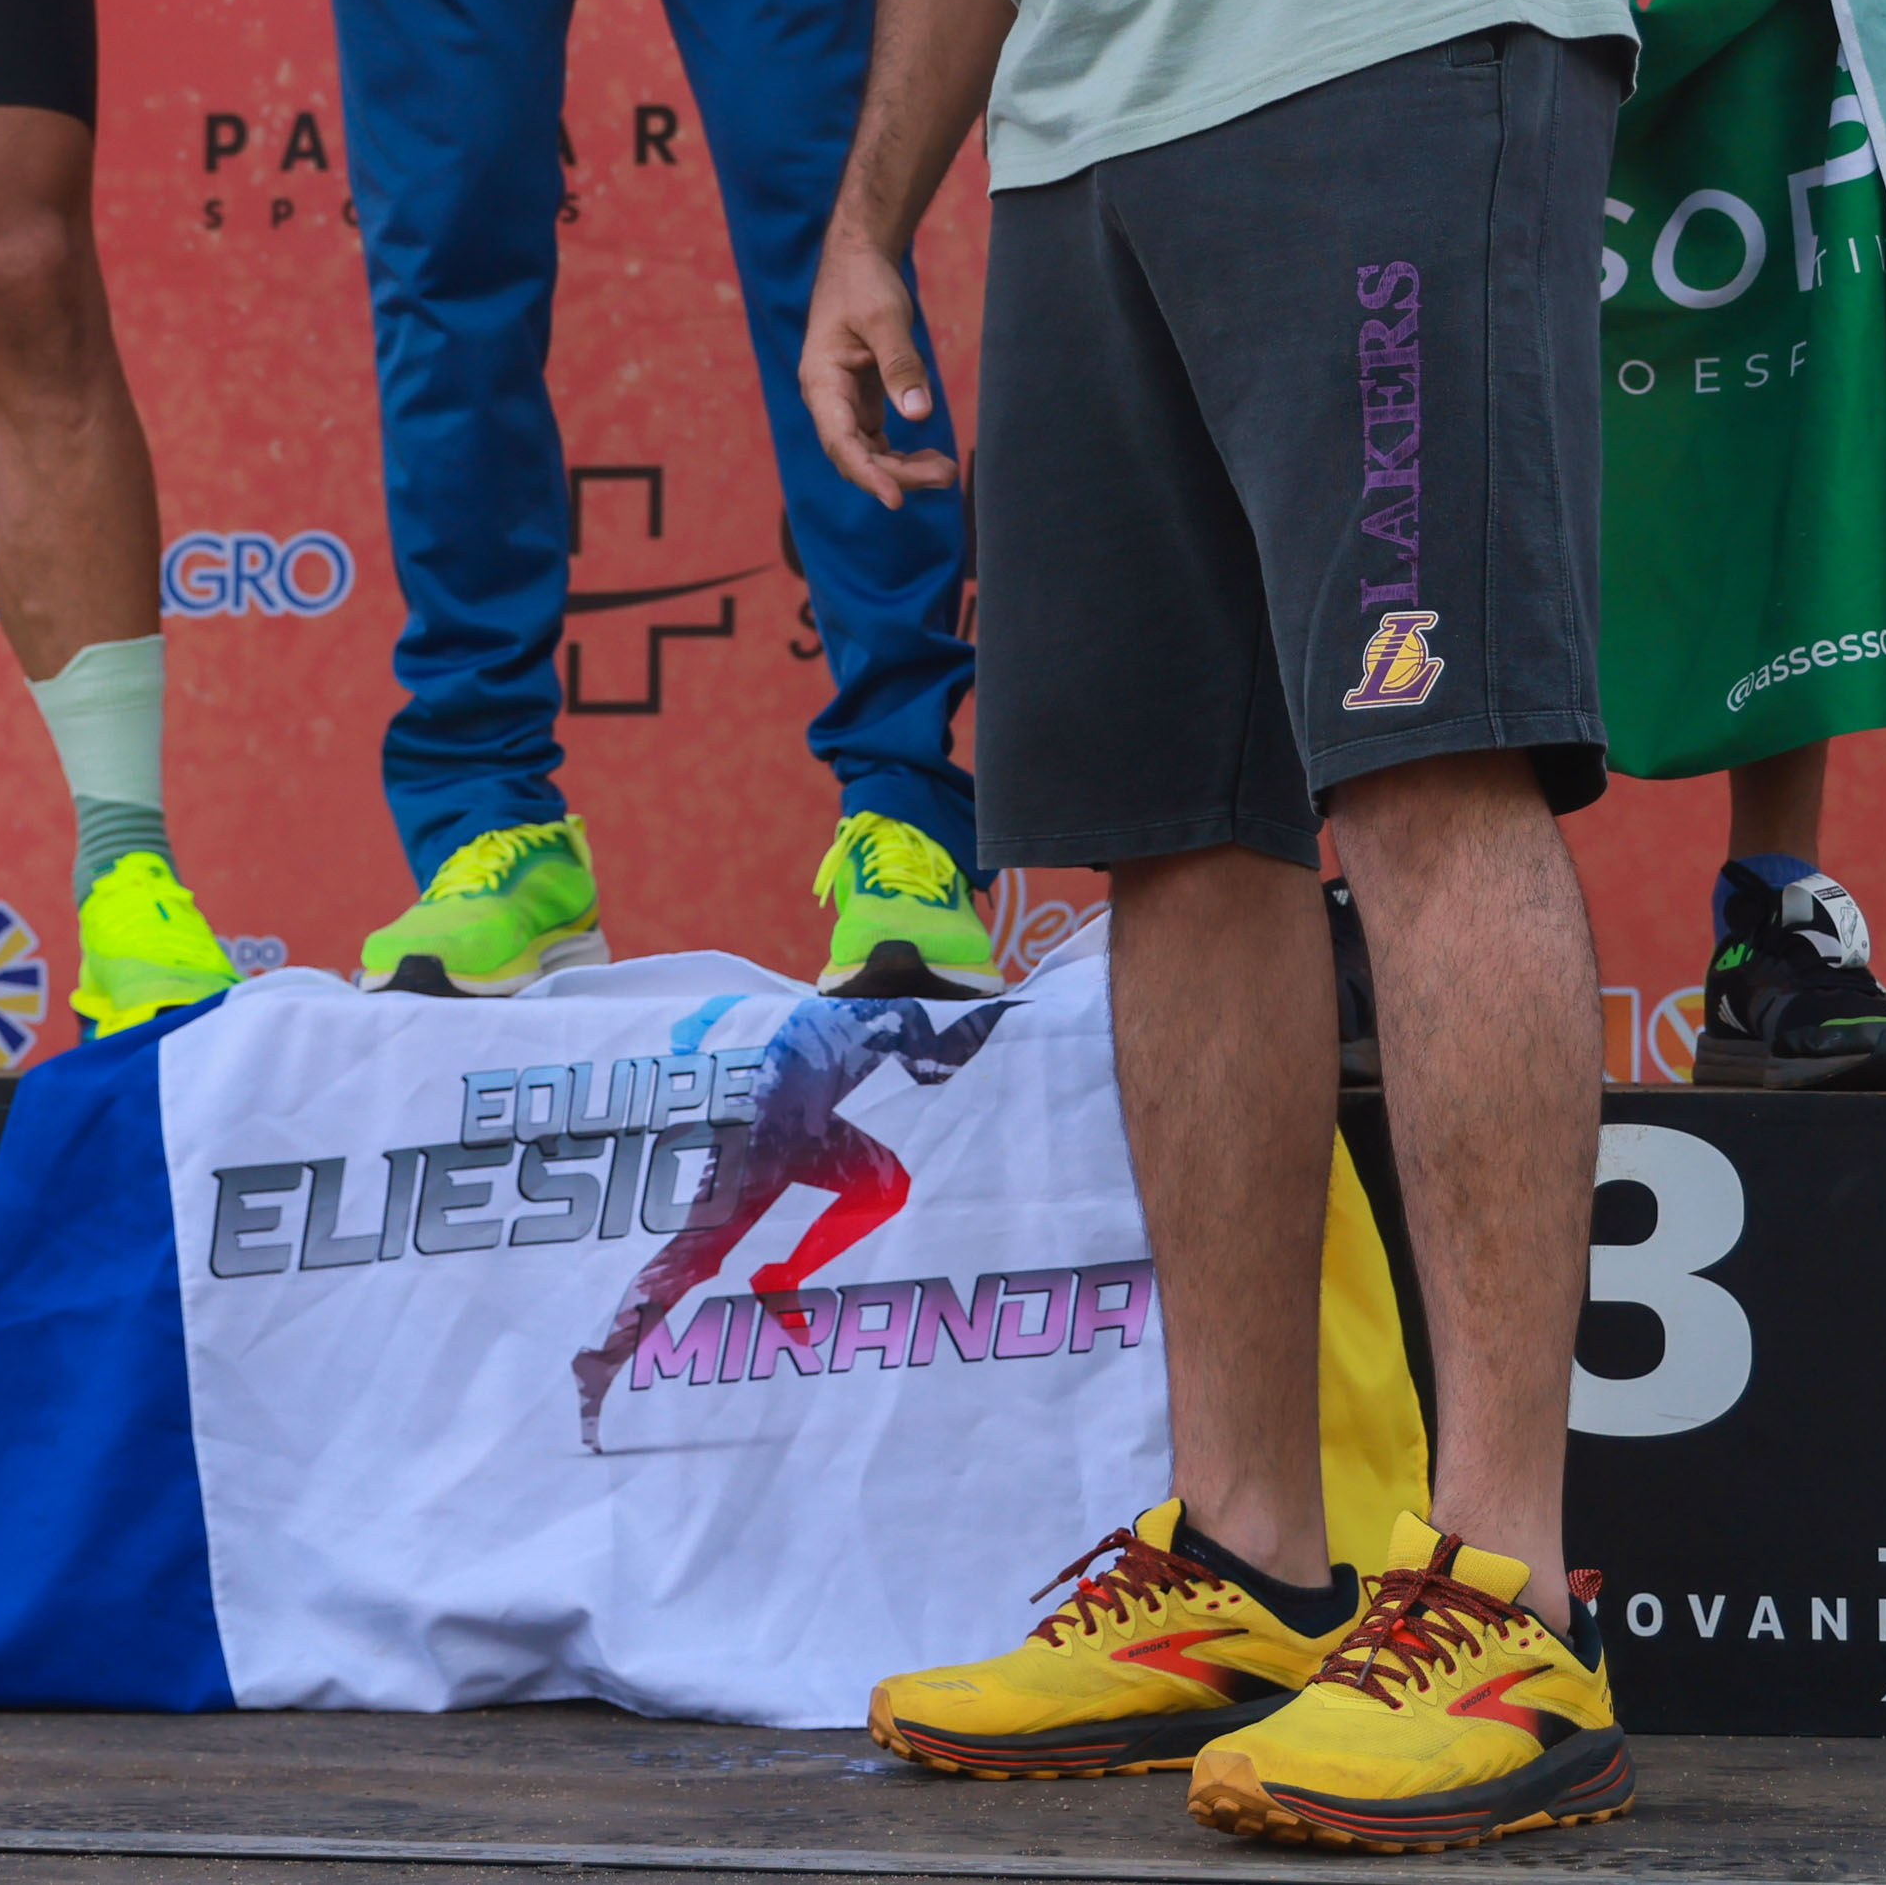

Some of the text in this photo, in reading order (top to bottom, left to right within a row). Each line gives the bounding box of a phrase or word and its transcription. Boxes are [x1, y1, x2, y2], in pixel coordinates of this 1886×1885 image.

[1357, 259, 1420, 612] LAKERS
[461, 1047, 766, 1153] EQUIPE
[209, 1120, 755, 1281] ELIESIO
[630, 1257, 1157, 1393] MIRANDA
[1566, 1123, 1753, 1437] 3
[1128, 1640, 1171, 1658] BROOKS
[1459, 1686, 1492, 1712] BROOKS
